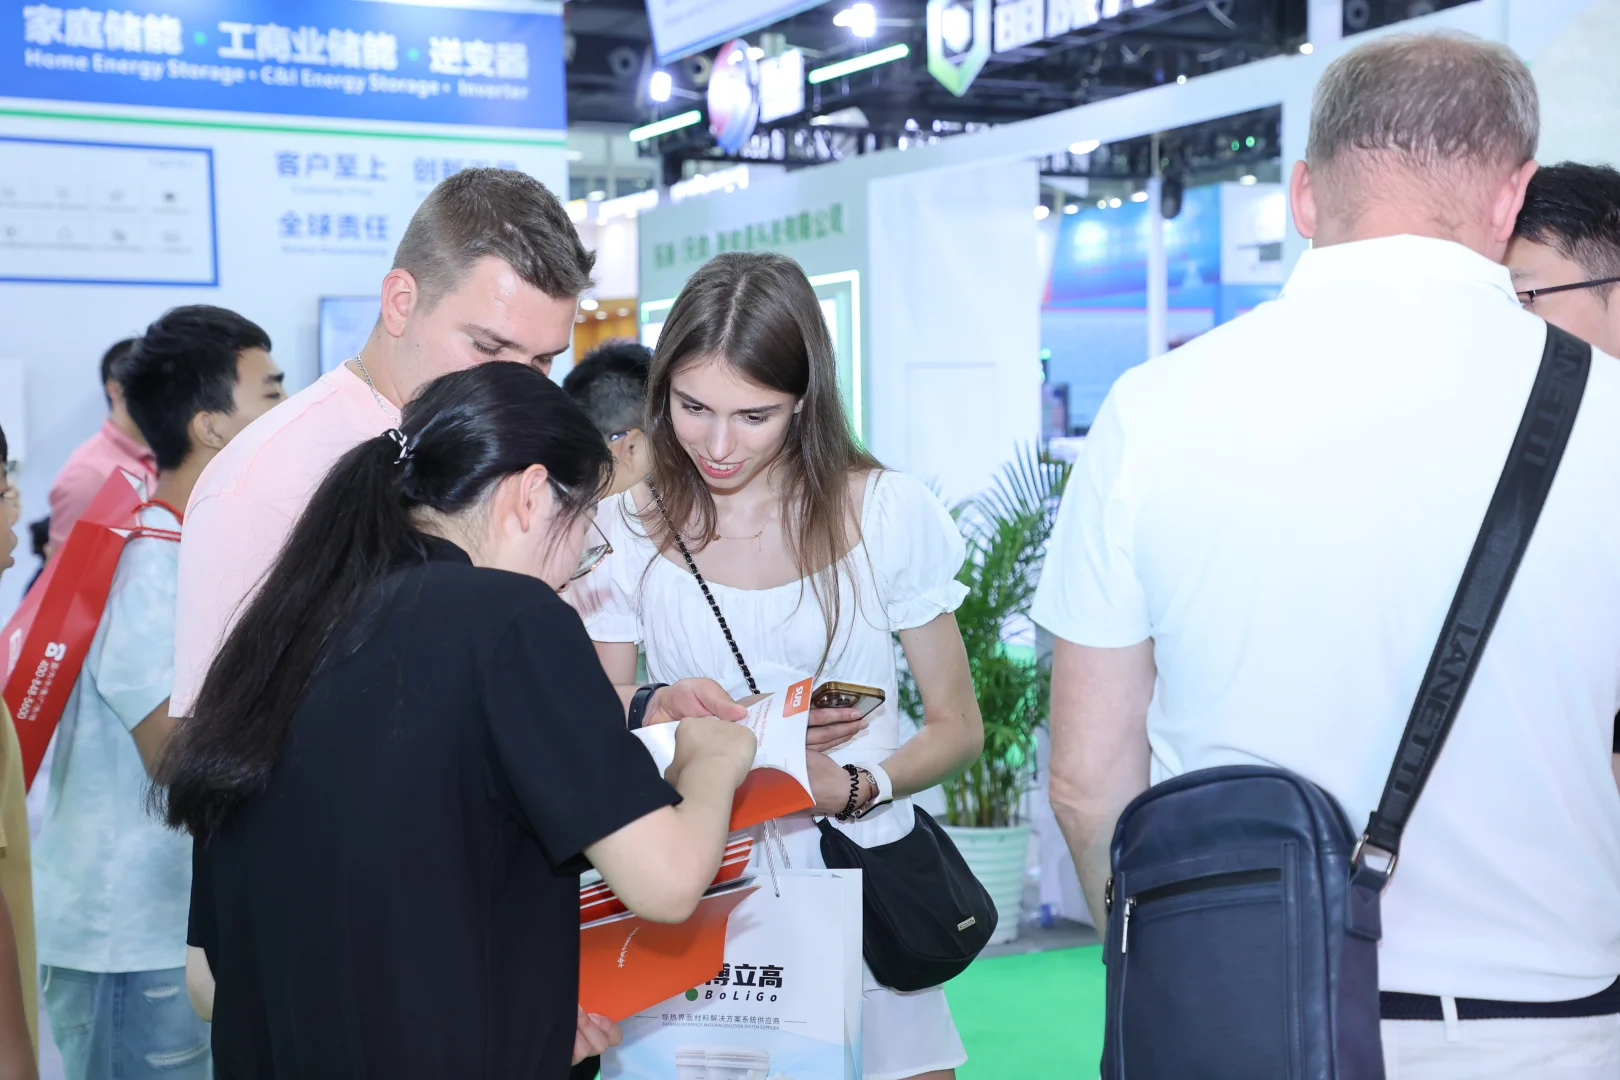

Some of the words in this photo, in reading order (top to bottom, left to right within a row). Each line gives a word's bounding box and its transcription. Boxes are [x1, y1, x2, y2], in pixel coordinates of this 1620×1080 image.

[23, 4, 184, 56] 家庭储能
[217, 22, 398, 71] 工商业储能
[428, 35, 529, 79] 逆变器
[24, 48, 89, 71] Home
[92, 53, 164, 81] Energy
[167, 58, 246, 87] Storage
[260, 65, 298, 86] C&I
[301, 69, 365, 95] Energy
[368, 72, 439, 99] Storage
[276, 151, 388, 181] 客户至上
[278, 209, 389, 241] 全球责任
[1523, 334, 1582, 467] ANETTI
[1394, 622, 1478, 794] LANETTI
[705, 990, 777, 1002] BoLiGo
